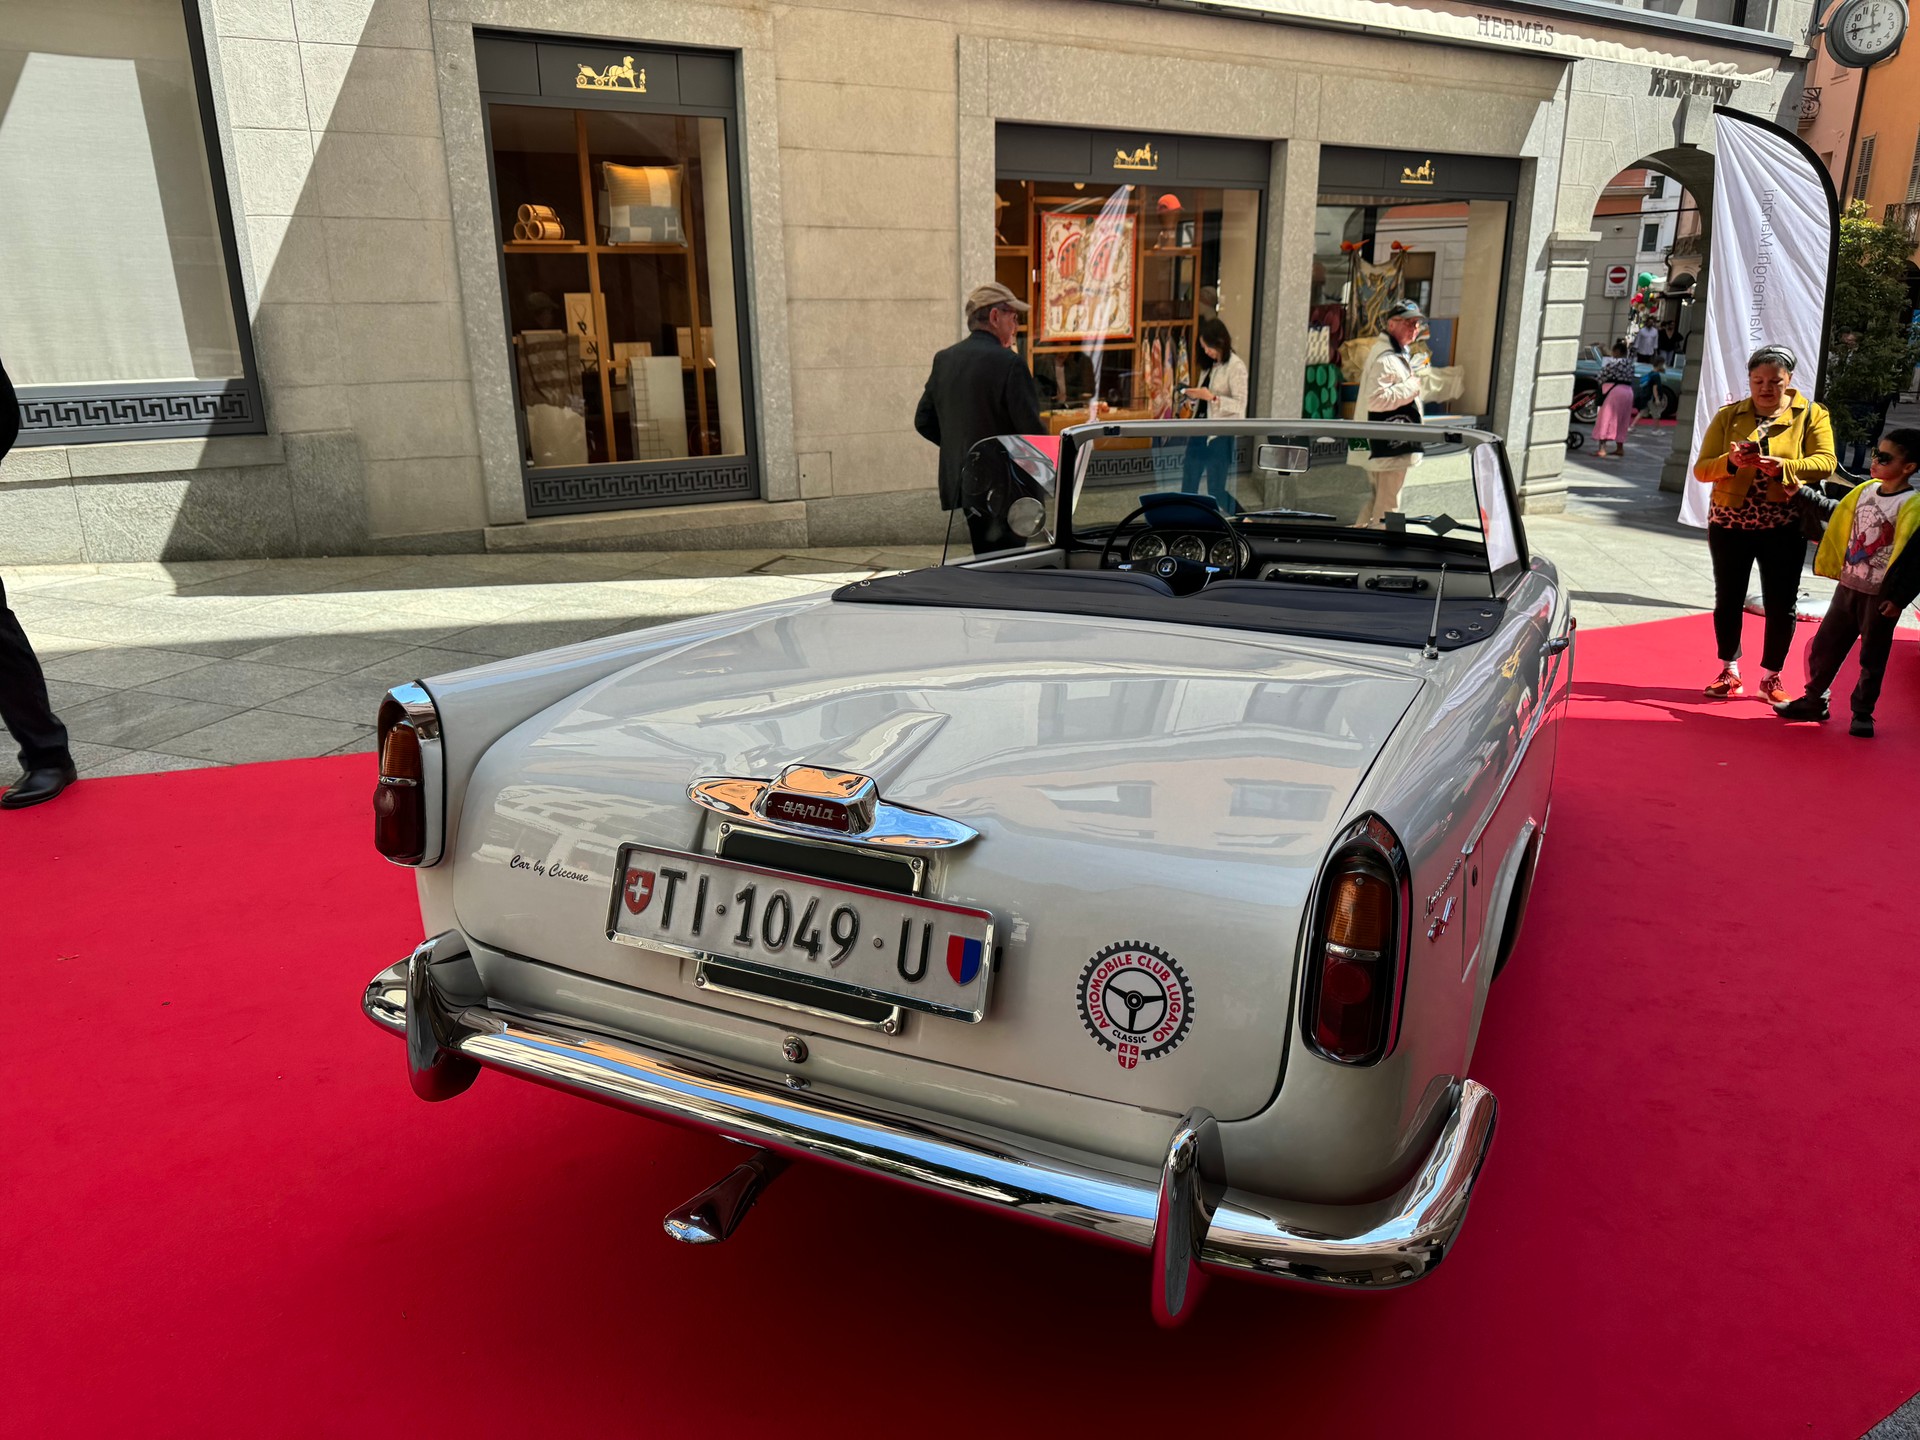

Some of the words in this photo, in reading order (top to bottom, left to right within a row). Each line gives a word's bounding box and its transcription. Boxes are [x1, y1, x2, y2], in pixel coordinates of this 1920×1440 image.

[1855, 14, 1862, 22] 10
[1863, 6, 1868, 15] 11
[1477, 14, 1554, 46] HERMÈS
[664, 216, 679, 240] H
[510, 854, 530, 870] Car
[533, 859, 546, 876] by
[548, 863, 589, 882] Ciccone
[1137, 954, 1171, 982] CLUB
[1088, 953, 1133, 1029] AUTOMOBILE
[1152, 982, 1182, 1043] LUGANO
[1112, 1029, 1148, 1044] CLASSIC
